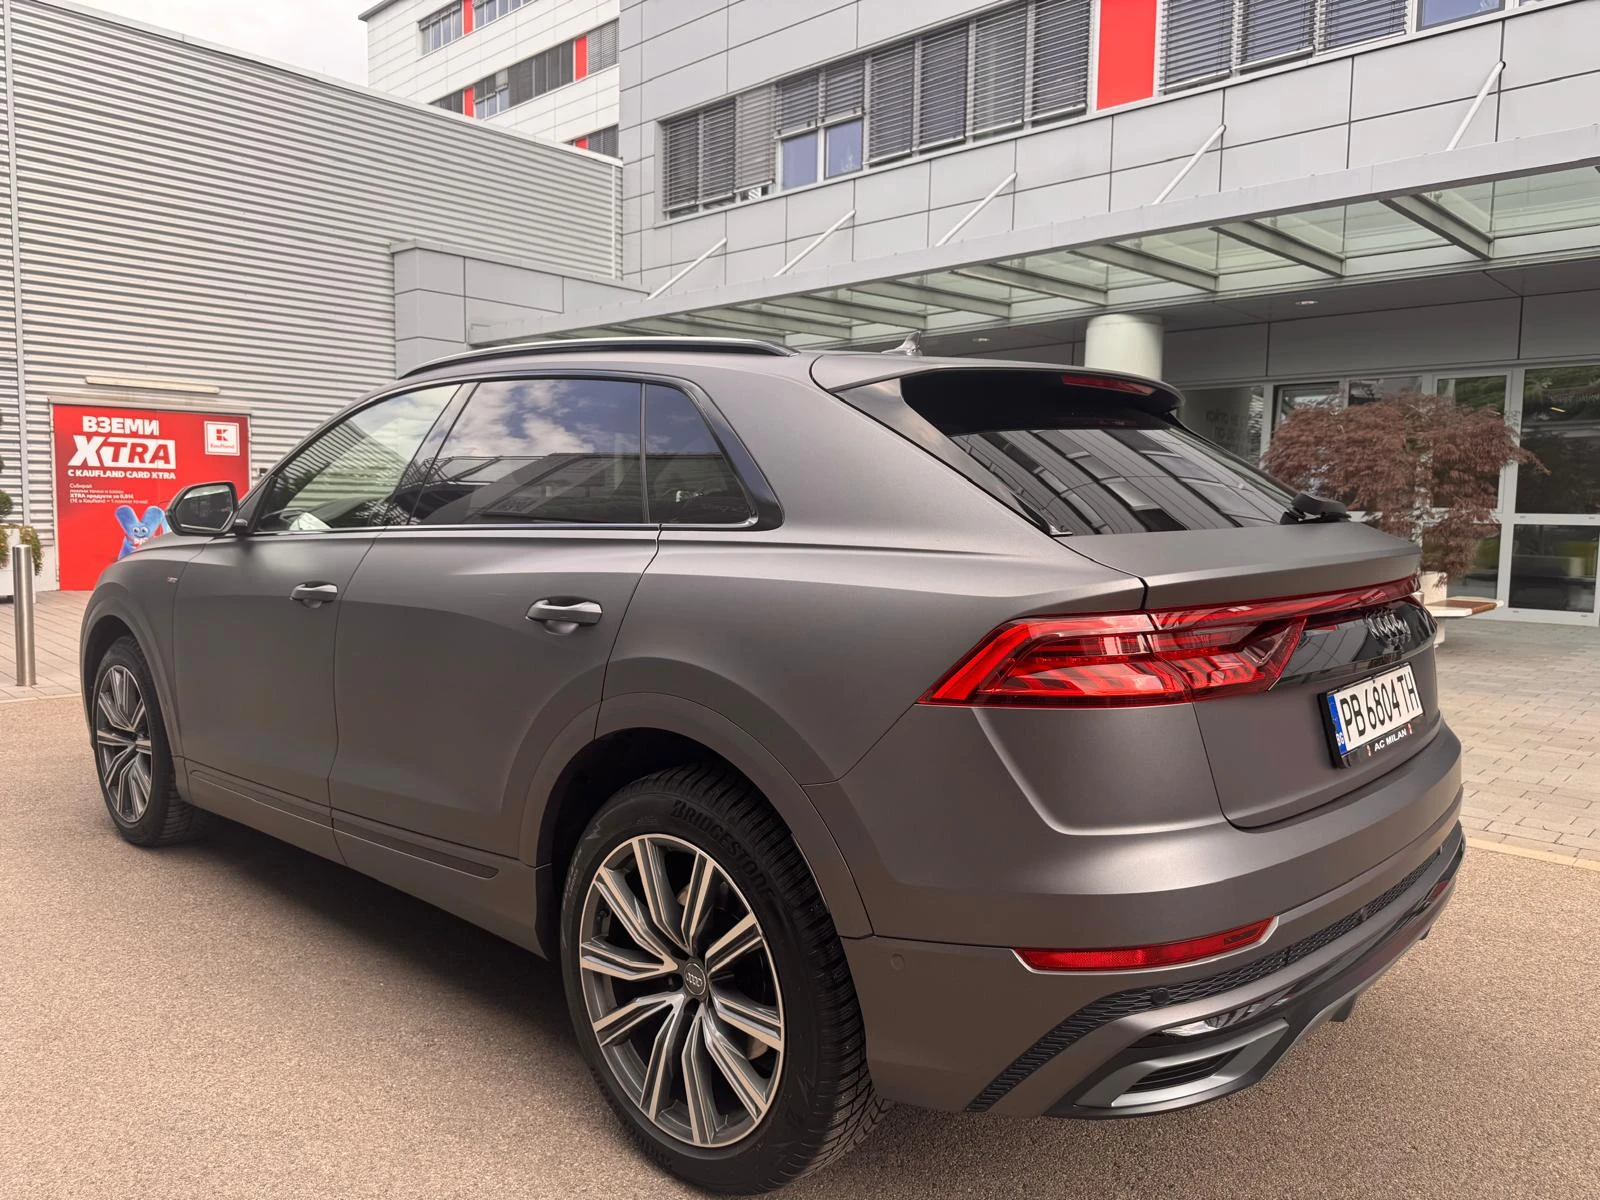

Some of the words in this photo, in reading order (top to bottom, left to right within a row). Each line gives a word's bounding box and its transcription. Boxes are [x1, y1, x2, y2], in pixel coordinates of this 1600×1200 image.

[82, 415, 160, 436] ВЗЕМИ
[68, 435, 174, 468] XTRA
[75, 469, 125, 479] KAUFLAND
[126, 470, 151, 479] CARD
[151, 471, 176, 480] XTRA
[1365, 679, 1402, 730] 6804
[1374, 740, 1385, 752] AC
[1386, 728, 1407, 745] MILAN
